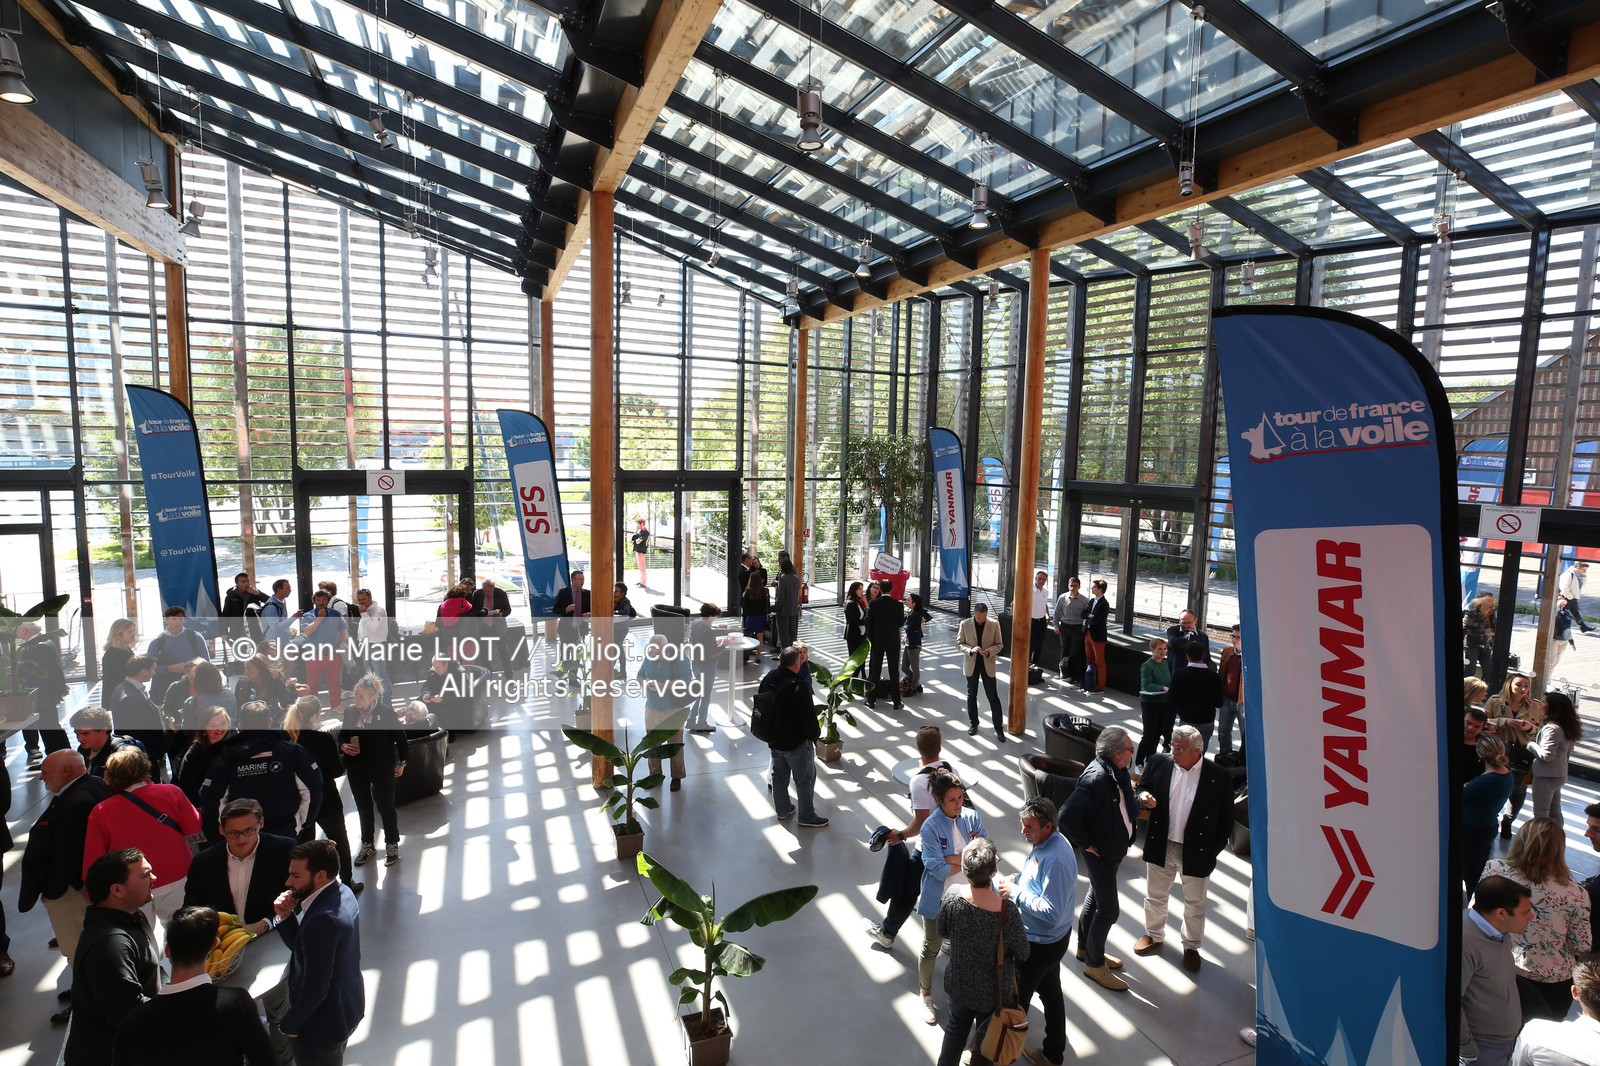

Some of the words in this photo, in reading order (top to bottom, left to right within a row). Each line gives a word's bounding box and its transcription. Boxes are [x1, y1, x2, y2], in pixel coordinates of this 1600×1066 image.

[1273, 410, 1321, 427] tour
[1323, 405, 1348, 422] de
[1348, 400, 1426, 419] france
[168, 422, 190, 431] voile
[1290, 426, 1309, 451] à
[1313, 425, 1337, 449] la
[1339, 416, 1430, 446] voile
[150, 470, 196, 480] #TourVoile
[945, 472, 956, 525] YANMAR
[181, 509, 202, 517] voile
[520, 486, 550, 534] SFS
[160, 545, 207, 557] @TourVoile
[1316, 539, 1369, 809] YANMAR
[237, 762, 268, 773] MARINE
